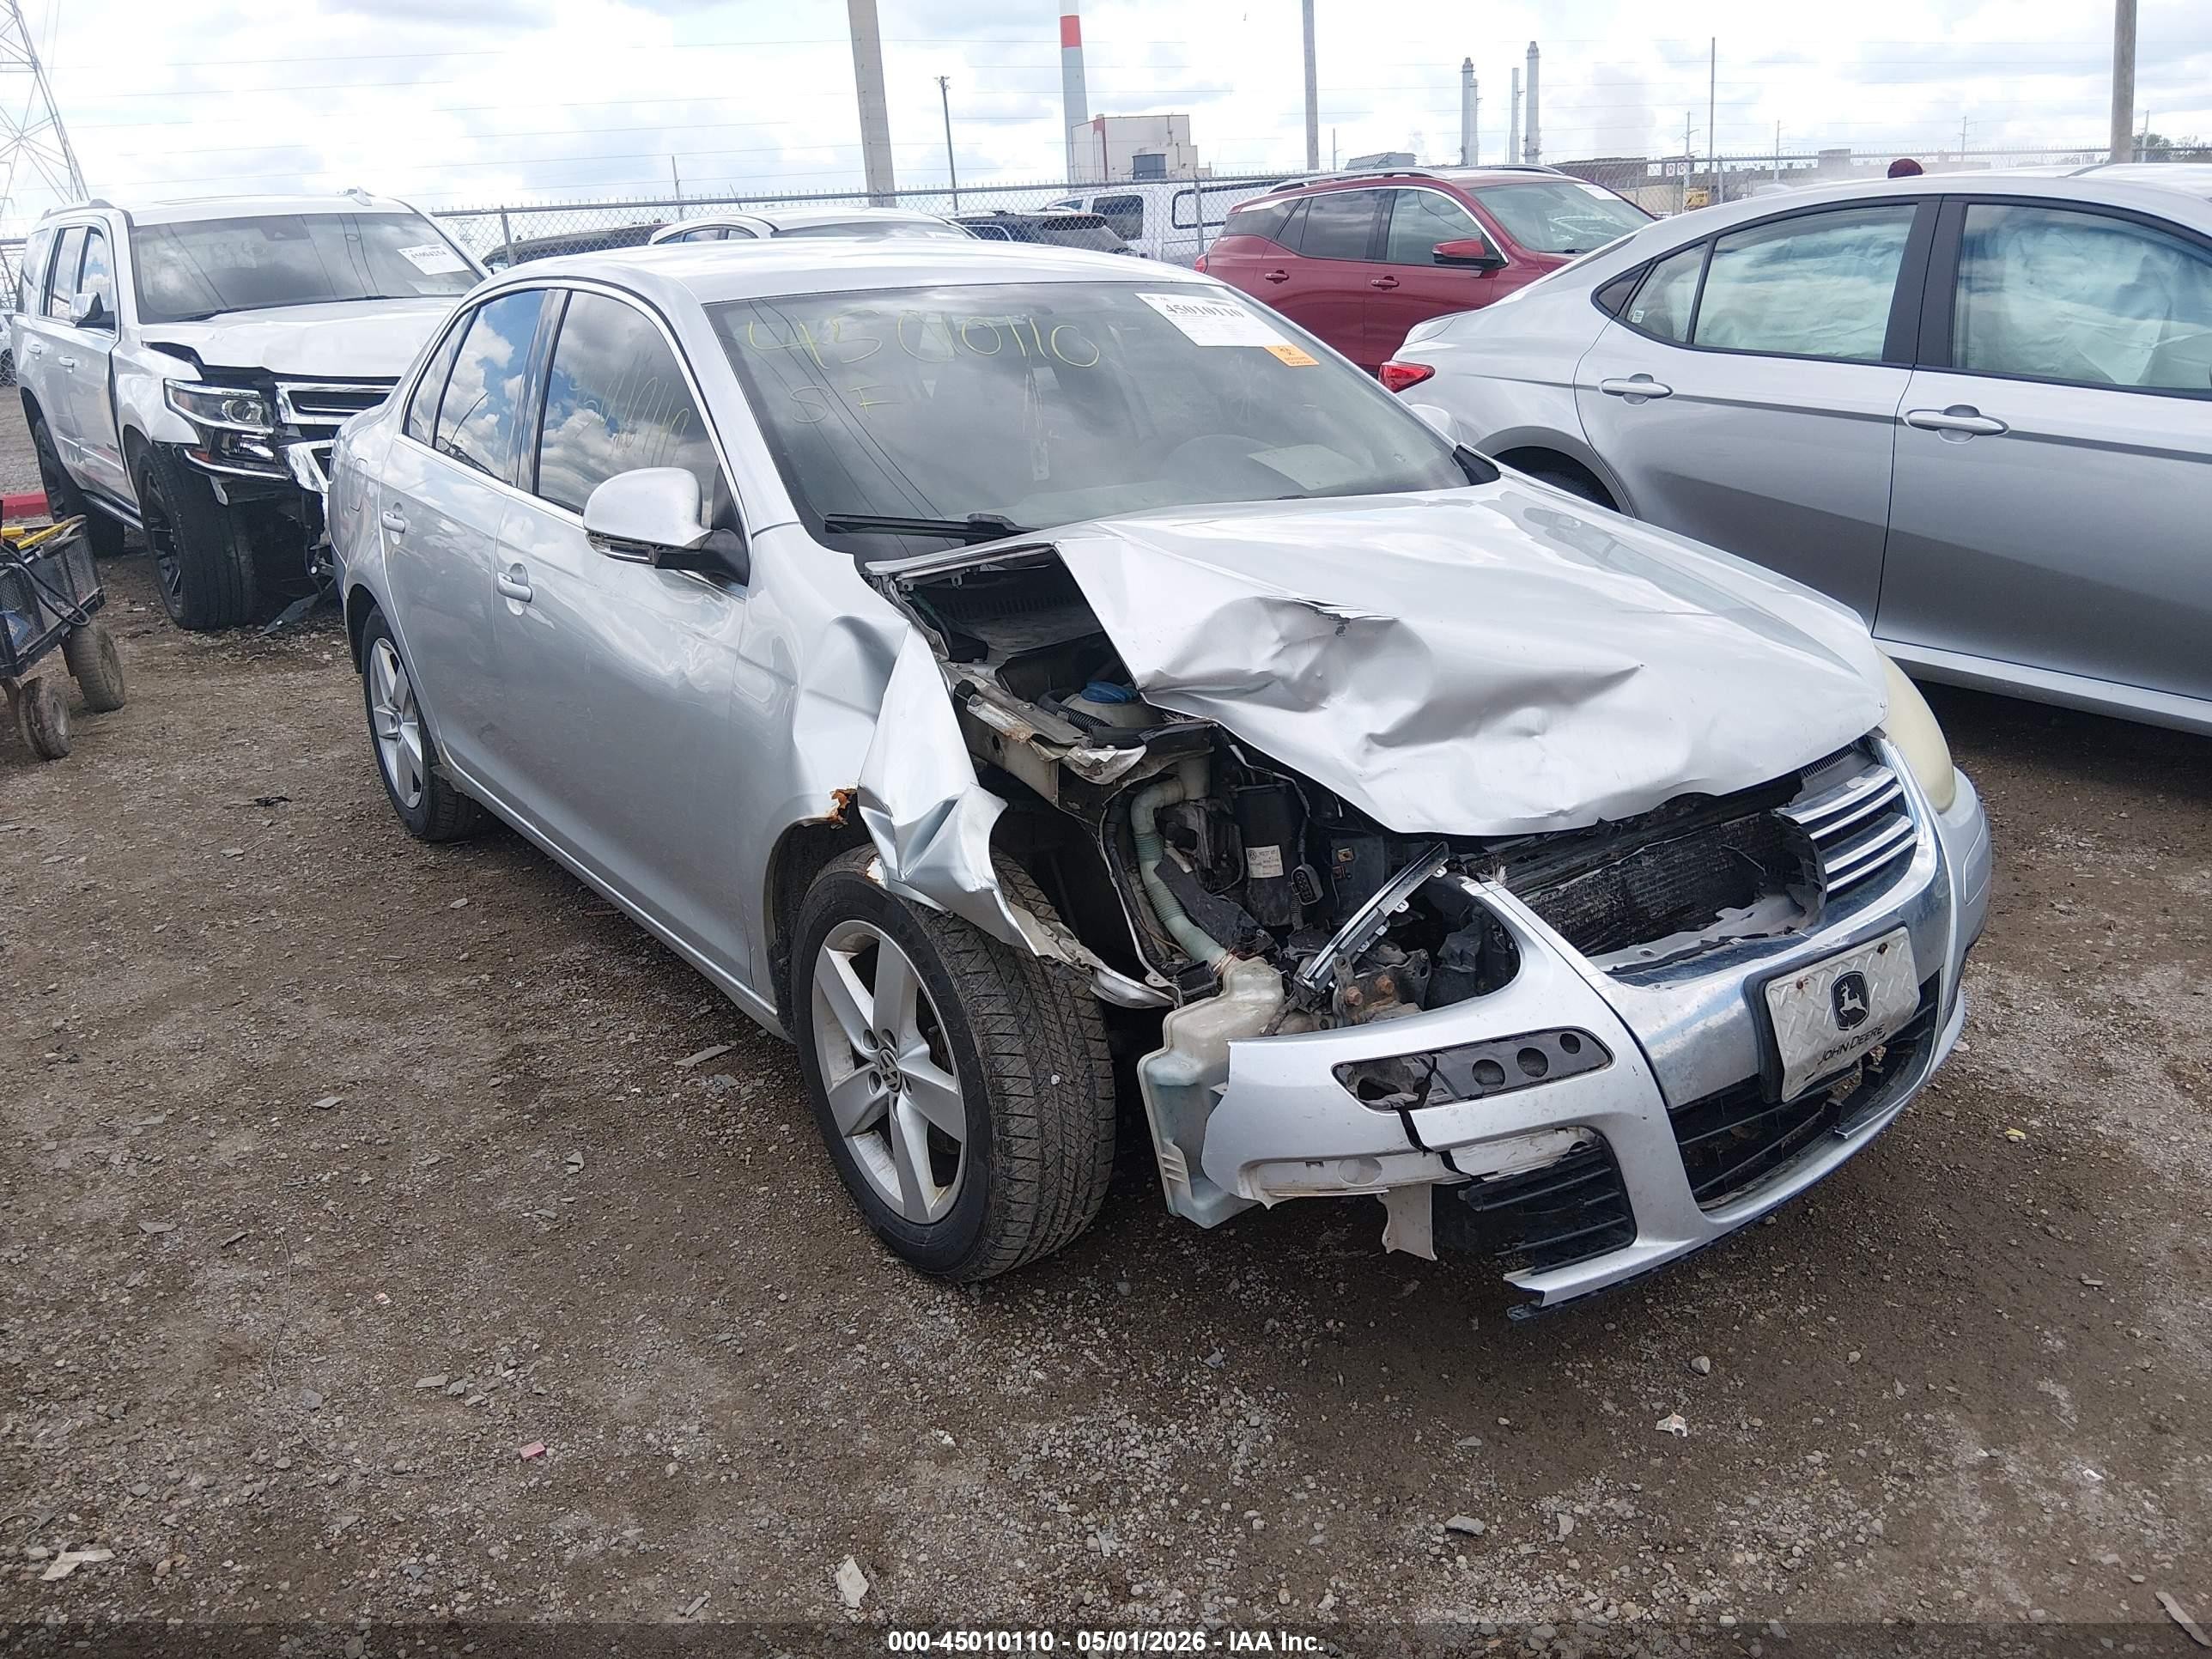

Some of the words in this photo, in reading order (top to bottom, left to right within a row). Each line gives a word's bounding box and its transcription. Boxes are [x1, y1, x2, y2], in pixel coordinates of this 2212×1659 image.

[1166, 304, 1245, 318] 45010110
[748, 308, 1100, 370] 45010110
[1817, 1041, 1850, 1066] JOHN
[1849, 1023, 1887, 1051] DEERE
